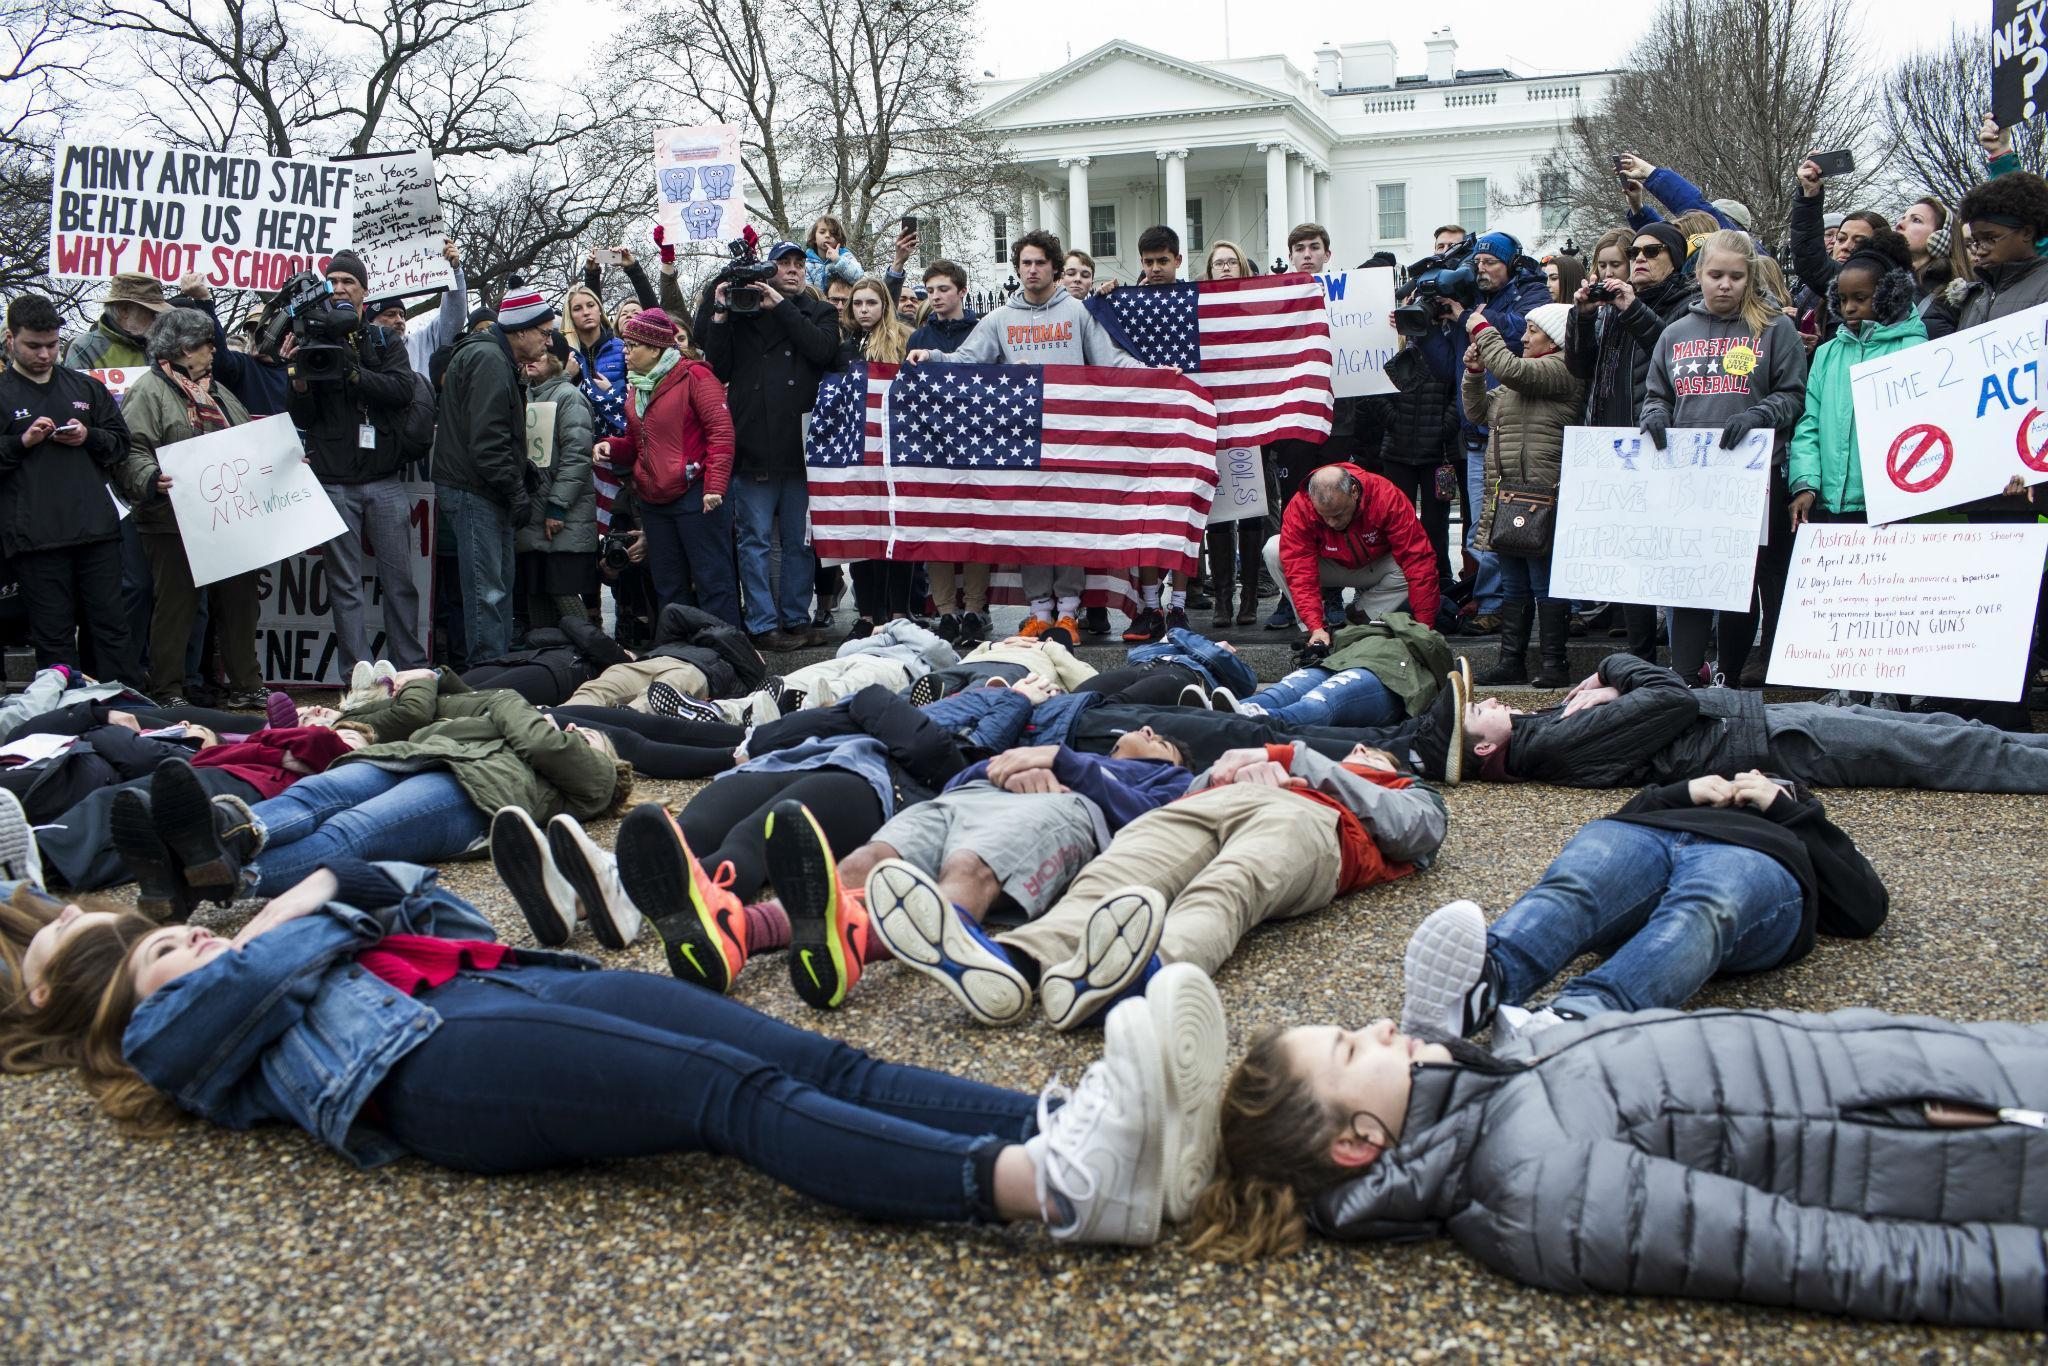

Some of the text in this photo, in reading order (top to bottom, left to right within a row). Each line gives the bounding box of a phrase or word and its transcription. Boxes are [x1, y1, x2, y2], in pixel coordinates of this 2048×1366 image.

[1993, 0, 2048, 68] NEX
[60, 145, 353, 209] MANY ARMED STAFF
[354, 163, 418, 183] een Years
[353, 186, 376, 200] fore
[396, 178, 432, 195] Second
[393, 197, 414, 208] the
[58, 191, 337, 254] BEHIND US HERE
[352, 215, 443, 245] entified Three Rights
[353, 220, 379, 234] unding
[353, 227, 445, 257] ore Important Than
[57, 234, 130, 277] WHY
[138, 239, 202, 282] NOT
[367, 262, 386, 280] ife,
[387, 249, 424, 273] Liberty
[389, 274, 401, 288] of
[404, 268, 449, 288] Happiness
[1328, 306, 1375, 328] time
[1007, 320, 1073, 345] POTOMAC
[1013, 341, 1068, 352] LACROSSE
[1337, 348, 1394, 375] AGAIN
[1853, 366, 1929, 411] TIME
[1934, 347, 1965, 388] 2
[1969, 330, 2040, 369] TAKE
[1675, 374, 1750, 397] BASEBALL
[1573, 431, 1642, 471] MY
[1745, 432, 1768, 471] 2
[1908, 452, 1944, 468] ootings
[200, 458, 250, 503] GOP
[1576, 479, 1649, 512] LIVE
[1703, 474, 1760, 519] MORE
[213, 488, 312, 532] NRA whores
[1809, 528, 1867, 549] Australia
[1872, 530, 1897, 546] had
[1922, 532, 1948, 543] worse
[1952, 531, 1982, 542] mass
[1801, 557, 1812, 565] on
[1817, 555, 1844, 572] April
[1564, 562, 1629, 596] YOUR
[1638, 563, 1708, 600] RIGHT
[1796, 576, 1807, 589] 12
[1810, 577, 1830, 593] Days
[1833, 575, 1853, 587] later
[1858, 572, 1905, 586] Australia
[1908, 574, 1950, 583] announced
[1812, 610, 1825, 619] The
[1827, 611, 1870, 622] government
[1919, 608, 1934, 616] and
[1938, 608, 1971, 618] destroyed
[1975, 603, 2003, 615] OVER
[1827, 617, 1965, 642] 1 MILLION GUNS
[1784, 643, 1831, 660] Australia
[1836, 647, 1854, 659] HAS
[1859, 647, 1883, 657] NOT
[1912, 645, 1933, 654] MASS
[1873, 661, 1906, 679] then
